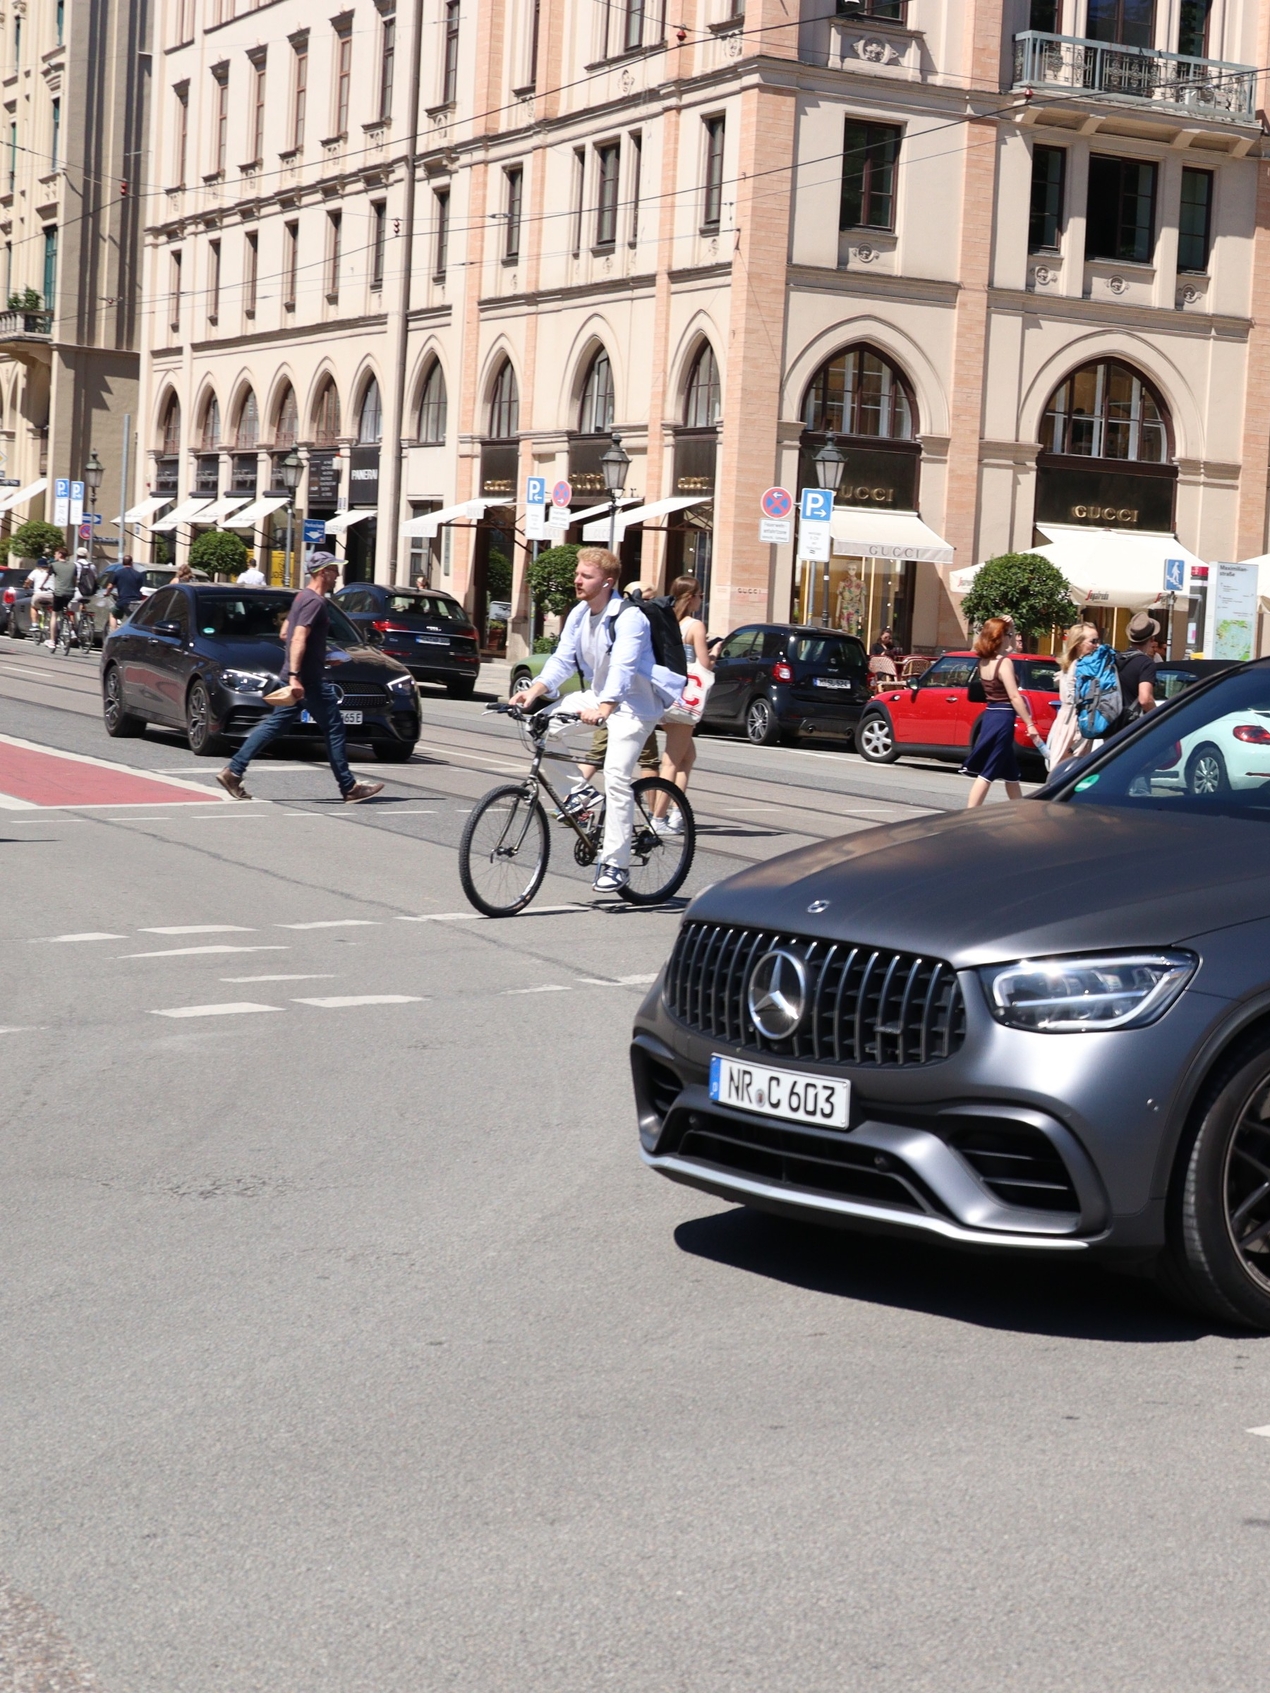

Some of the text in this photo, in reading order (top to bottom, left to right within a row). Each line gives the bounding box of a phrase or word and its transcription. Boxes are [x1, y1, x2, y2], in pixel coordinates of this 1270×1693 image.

[528, 480, 540, 501] P
[805, 493, 824, 516] P
[1071, 505, 1138, 522] GUCCI
[869, 545, 920, 558] GUCCI
[728, 1066, 753, 1104] NR
[768, 1076, 780, 1109] C
[788, 1080, 835, 1119] 603
